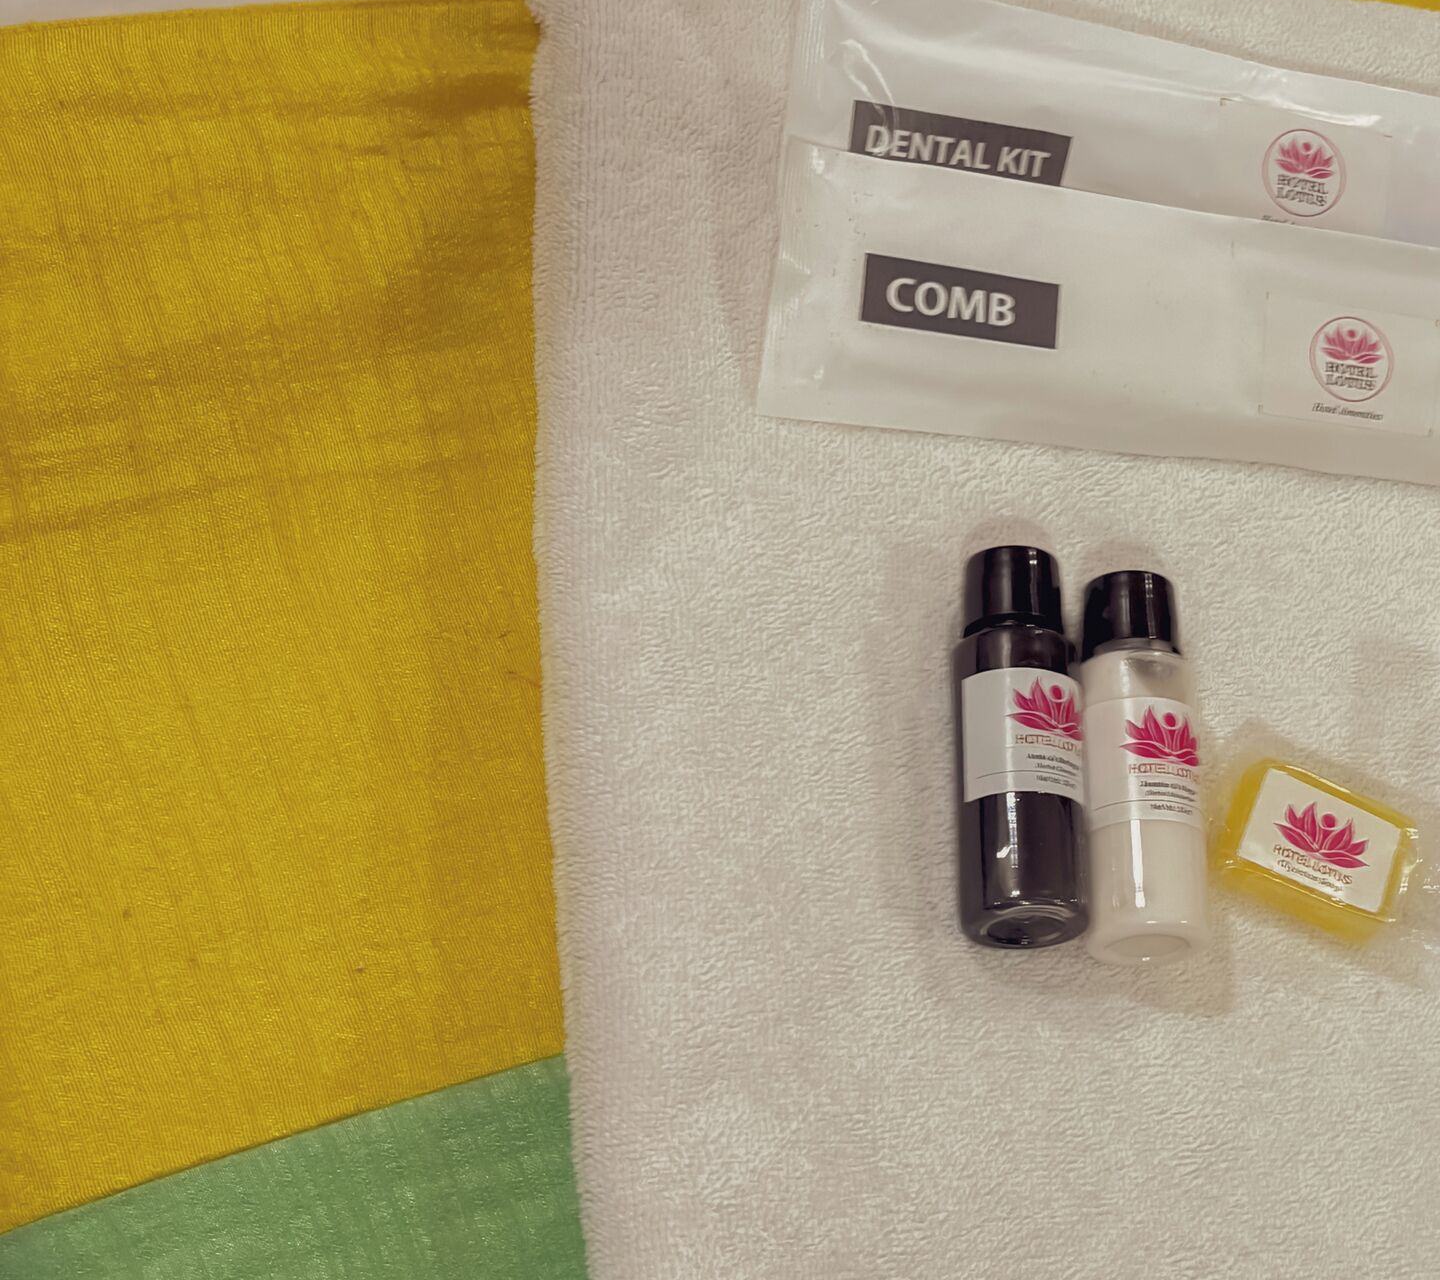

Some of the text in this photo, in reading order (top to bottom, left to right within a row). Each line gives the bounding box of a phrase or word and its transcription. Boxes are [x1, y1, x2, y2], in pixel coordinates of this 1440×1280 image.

[865, 124, 1051, 178] DENTAL KIT
[886, 277, 1016, 327] COMB
